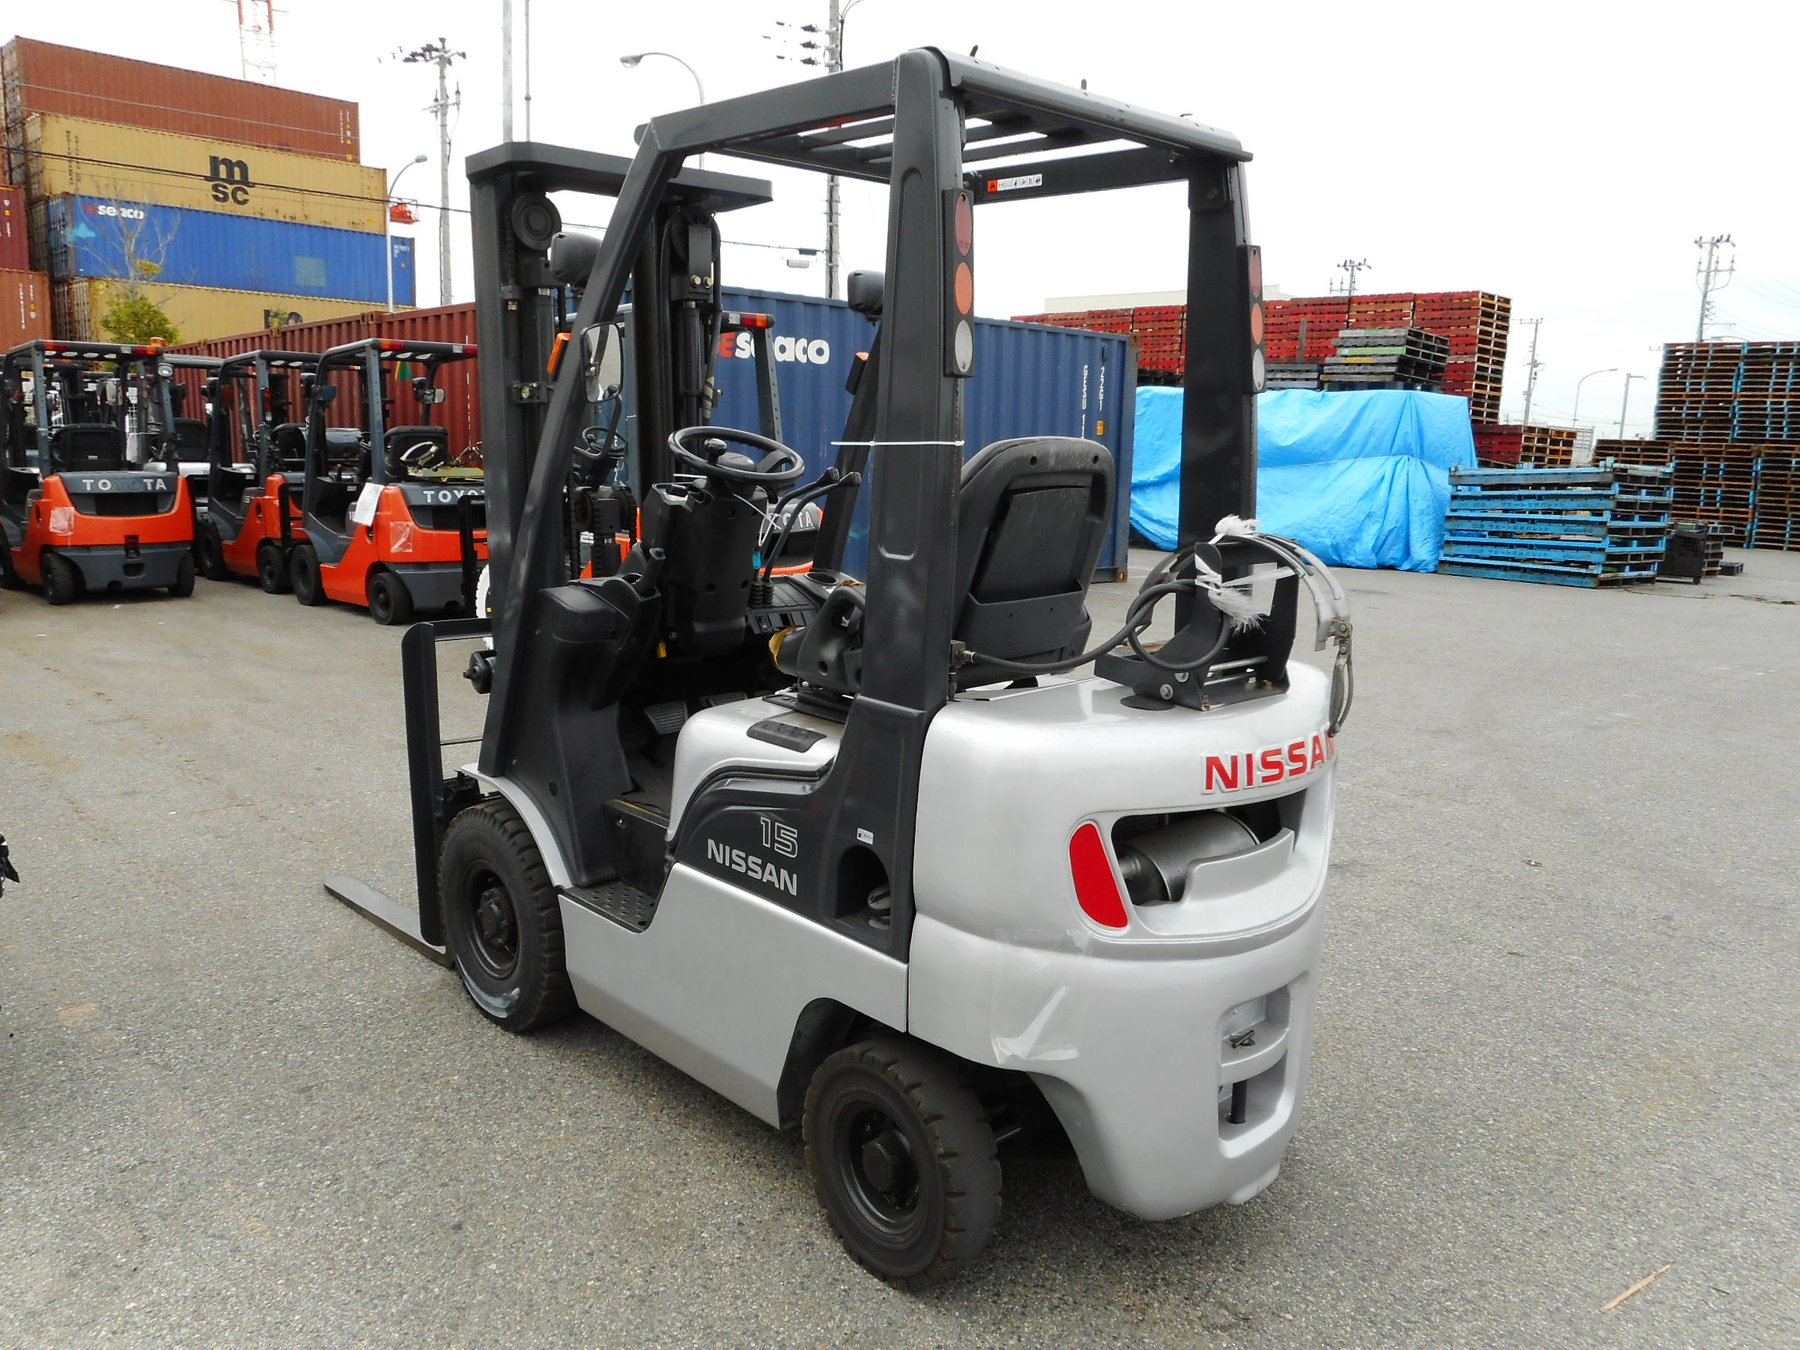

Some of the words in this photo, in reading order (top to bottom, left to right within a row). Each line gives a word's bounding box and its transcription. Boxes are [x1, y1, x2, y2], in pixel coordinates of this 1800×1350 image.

[1203, 728, 1336, 791] NISSAN
[760, 816, 798, 858] 15
[707, 838, 798, 896] NISSAN
